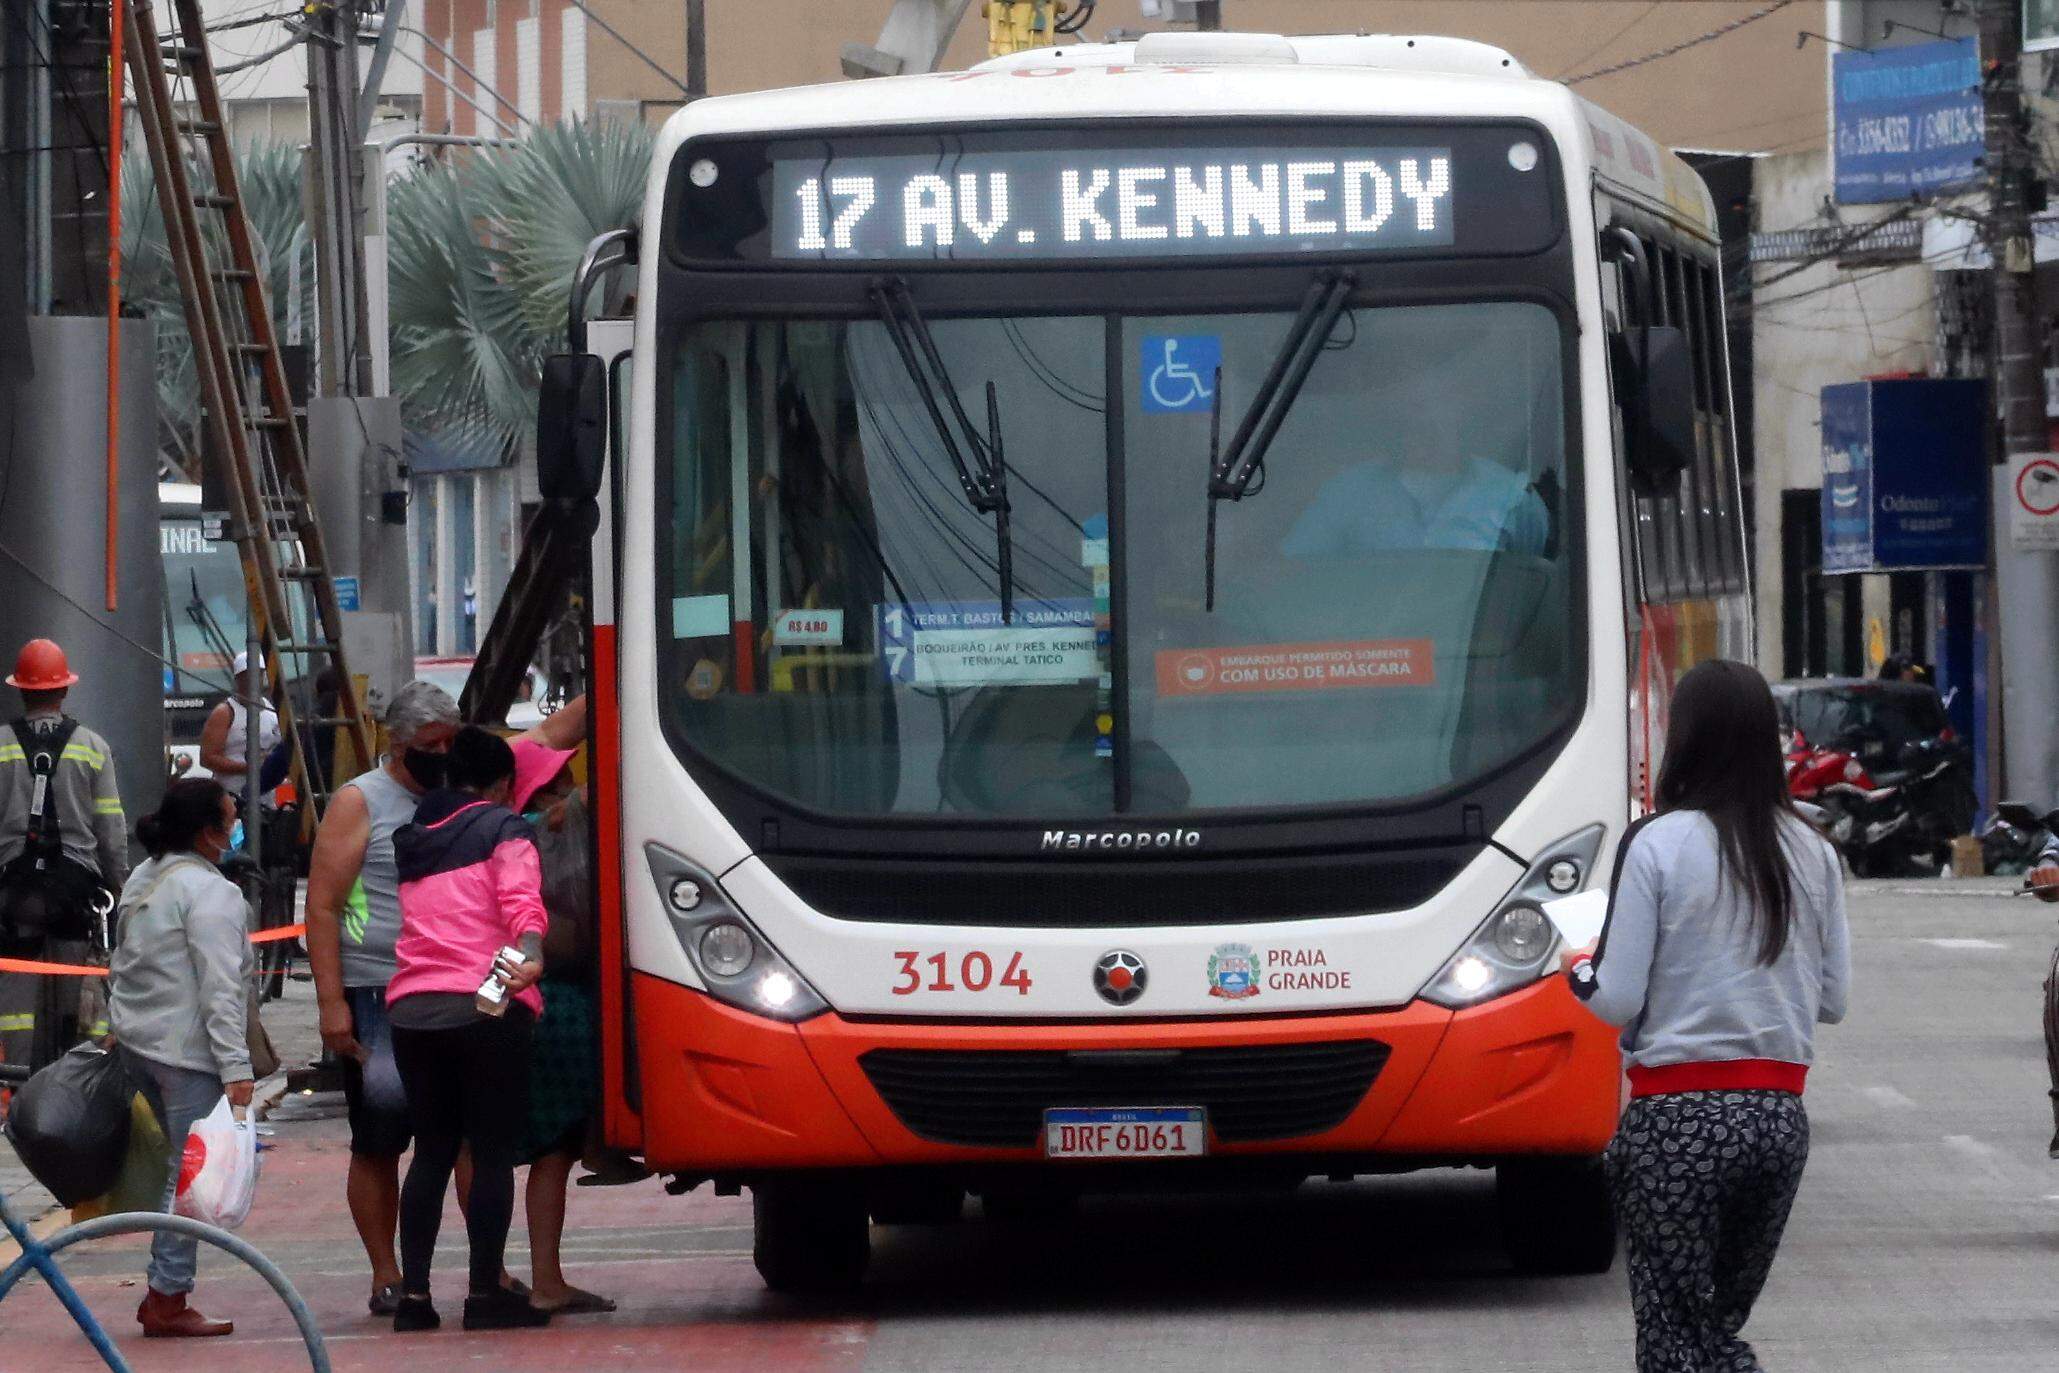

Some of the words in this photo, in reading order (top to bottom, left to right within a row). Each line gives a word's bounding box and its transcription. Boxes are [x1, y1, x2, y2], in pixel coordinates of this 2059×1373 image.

[797, 178, 875, 249] 17
[904, 172, 1035, 246] AV.
[1061, 158, 1449, 242] KENNEDY
[1220, 669, 1260, 683] COM
[1264, 666, 1299, 681] USO
[1303, 664, 1325, 679] DE
[1330, 661, 1412, 677] MÁSCARA
[1041, 829, 1200, 850] Marcopolo
[1267, 949, 1327, 967] PRAIA
[893, 950, 1032, 996] 3104
[1268, 971, 1351, 990] GRANDE
[1060, 1125, 1187, 1152] DRF6D61
